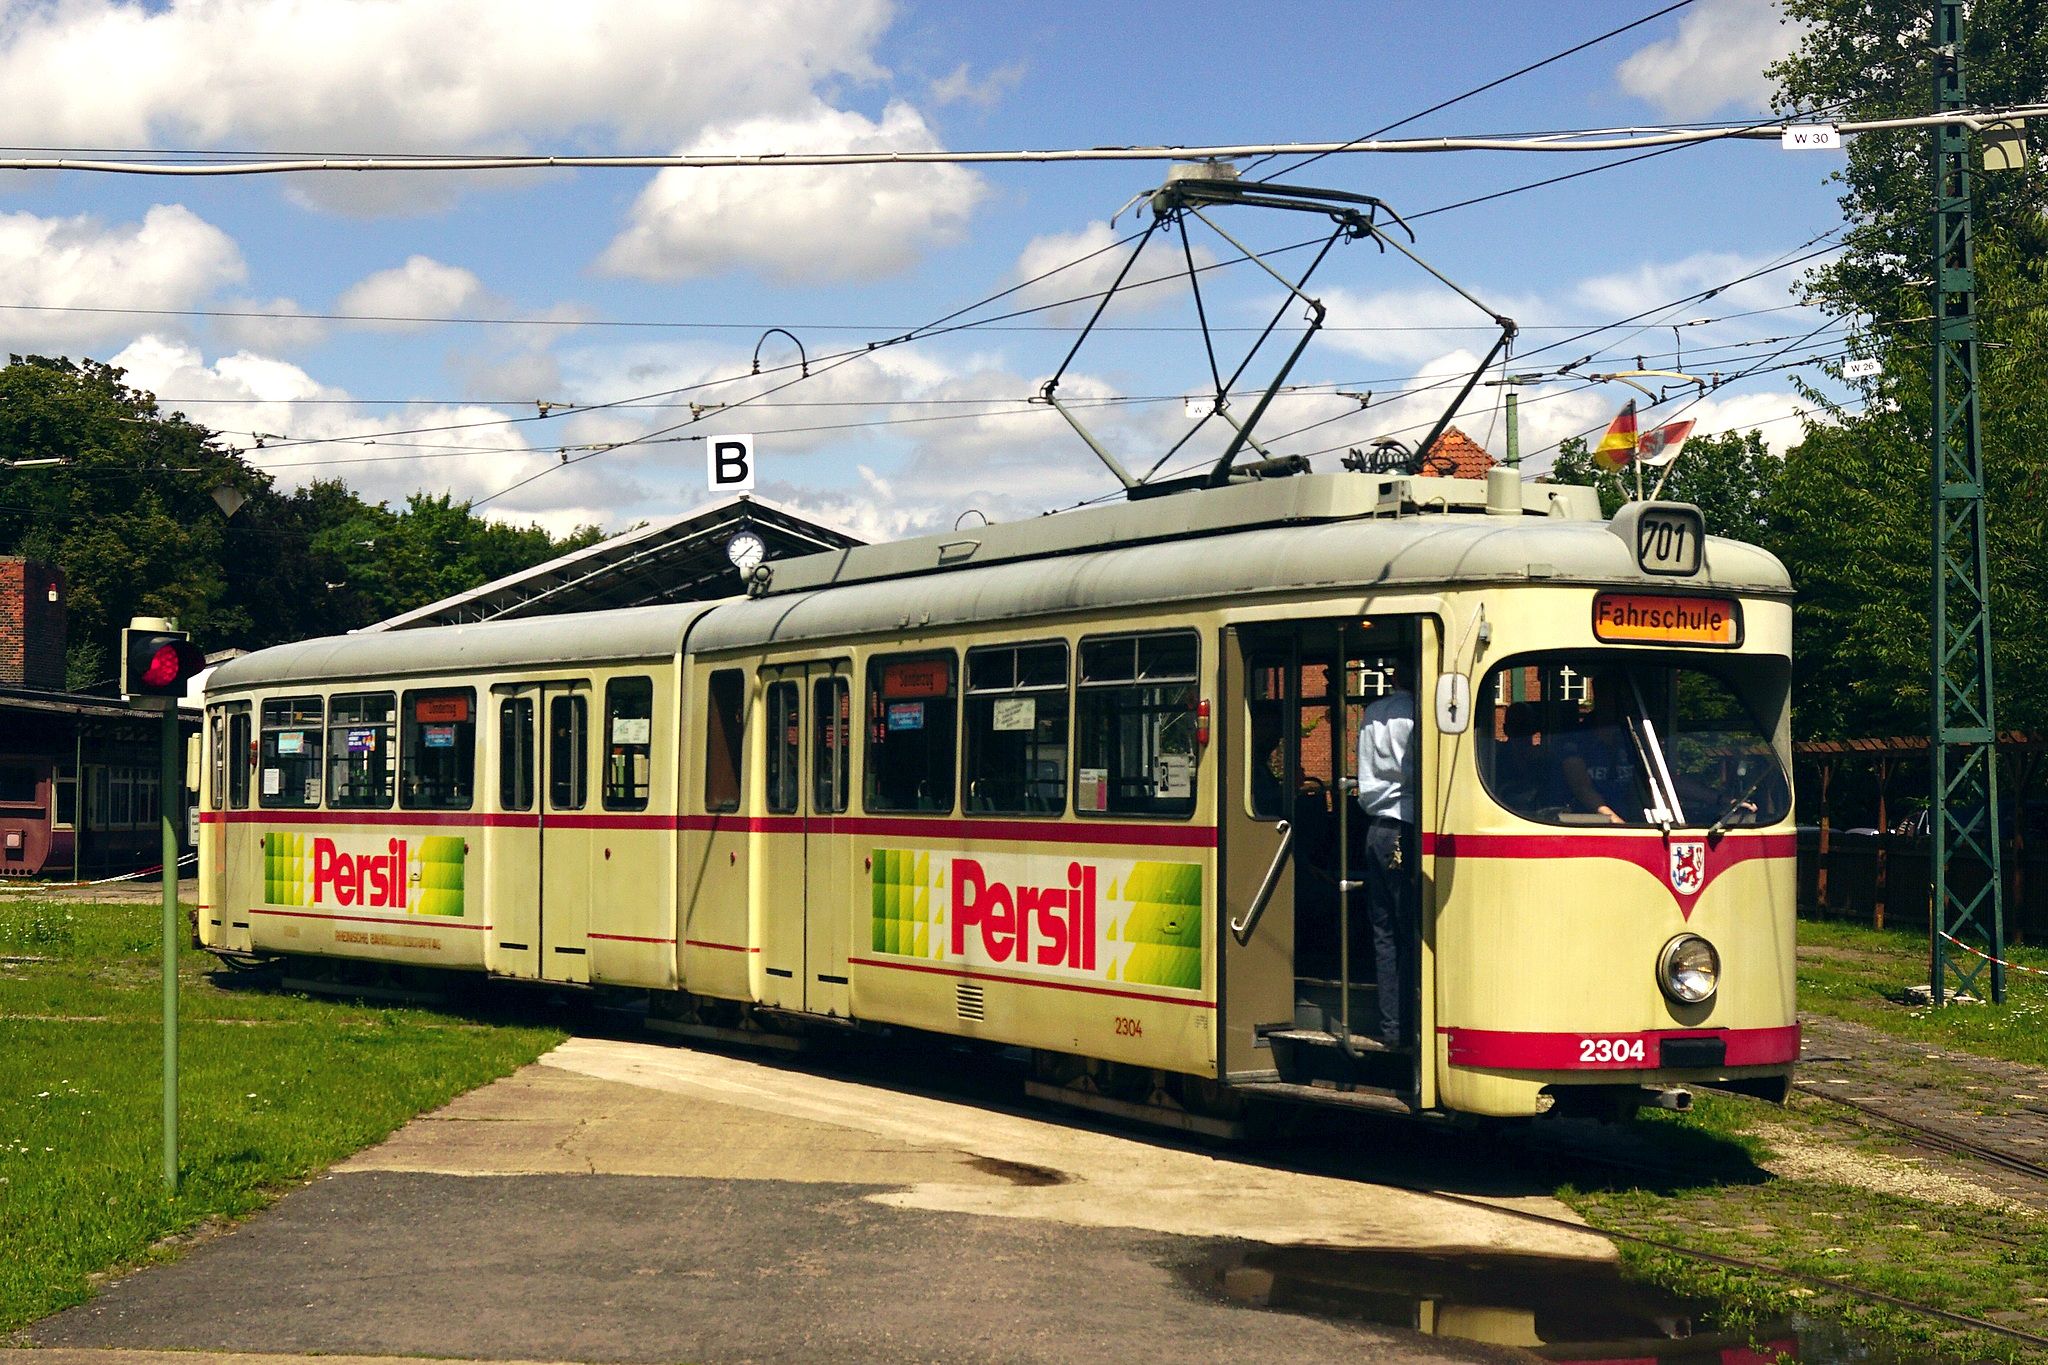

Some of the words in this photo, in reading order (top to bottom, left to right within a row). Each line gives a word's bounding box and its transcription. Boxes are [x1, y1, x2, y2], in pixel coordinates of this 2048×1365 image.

[1794, 133, 1808, 144] W
[1812, 133, 1829, 144] 30
[1850, 364, 1860, 372] W
[1862, 361, 1874, 371] 26
[715, 441, 749, 485] B
[1641, 519, 1687, 563] 701
[1598, 600, 1723, 632] Fahrschule
[313, 837, 407, 909] Persil
[951, 858, 1097, 971] Persil
[1114, 1016, 1143, 1038] 2304
[1579, 1039, 1646, 1062] 2304
